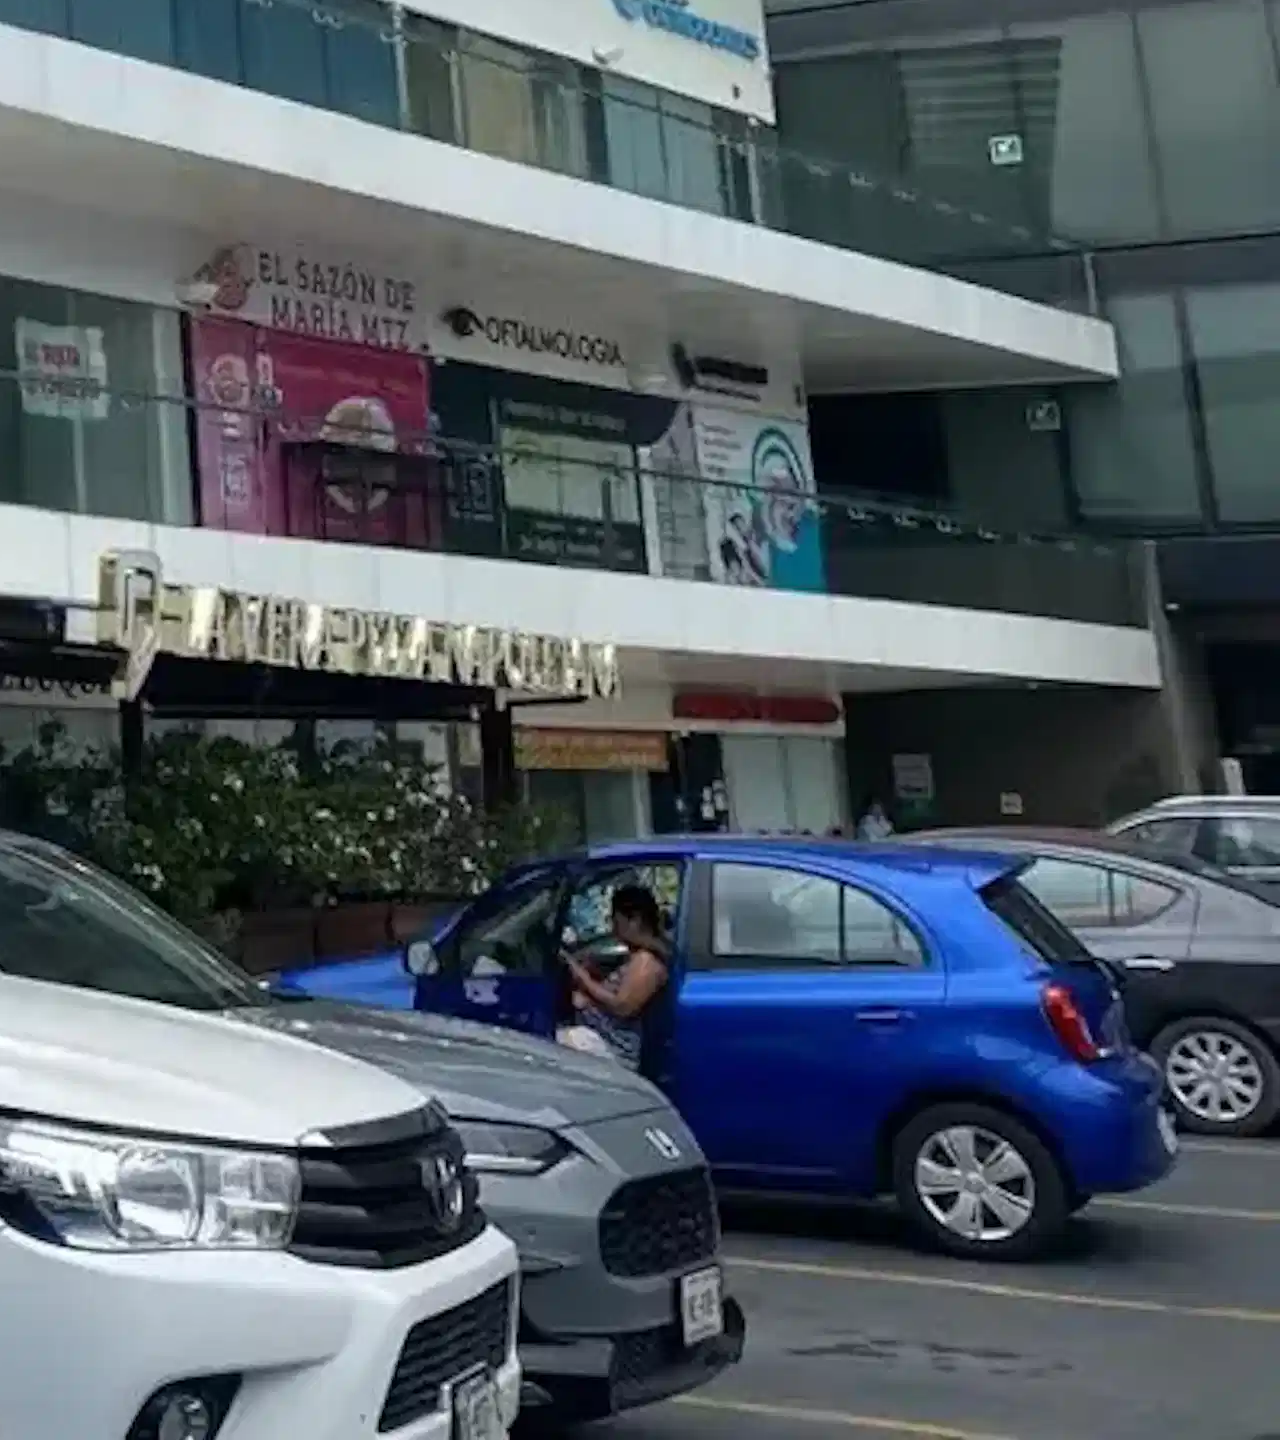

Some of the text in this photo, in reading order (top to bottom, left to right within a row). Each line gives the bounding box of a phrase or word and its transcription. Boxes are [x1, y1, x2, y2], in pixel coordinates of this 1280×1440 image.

[258, 251, 416, 312] EL SAZÓN DE
[272, 295, 353, 339] MARÍA
